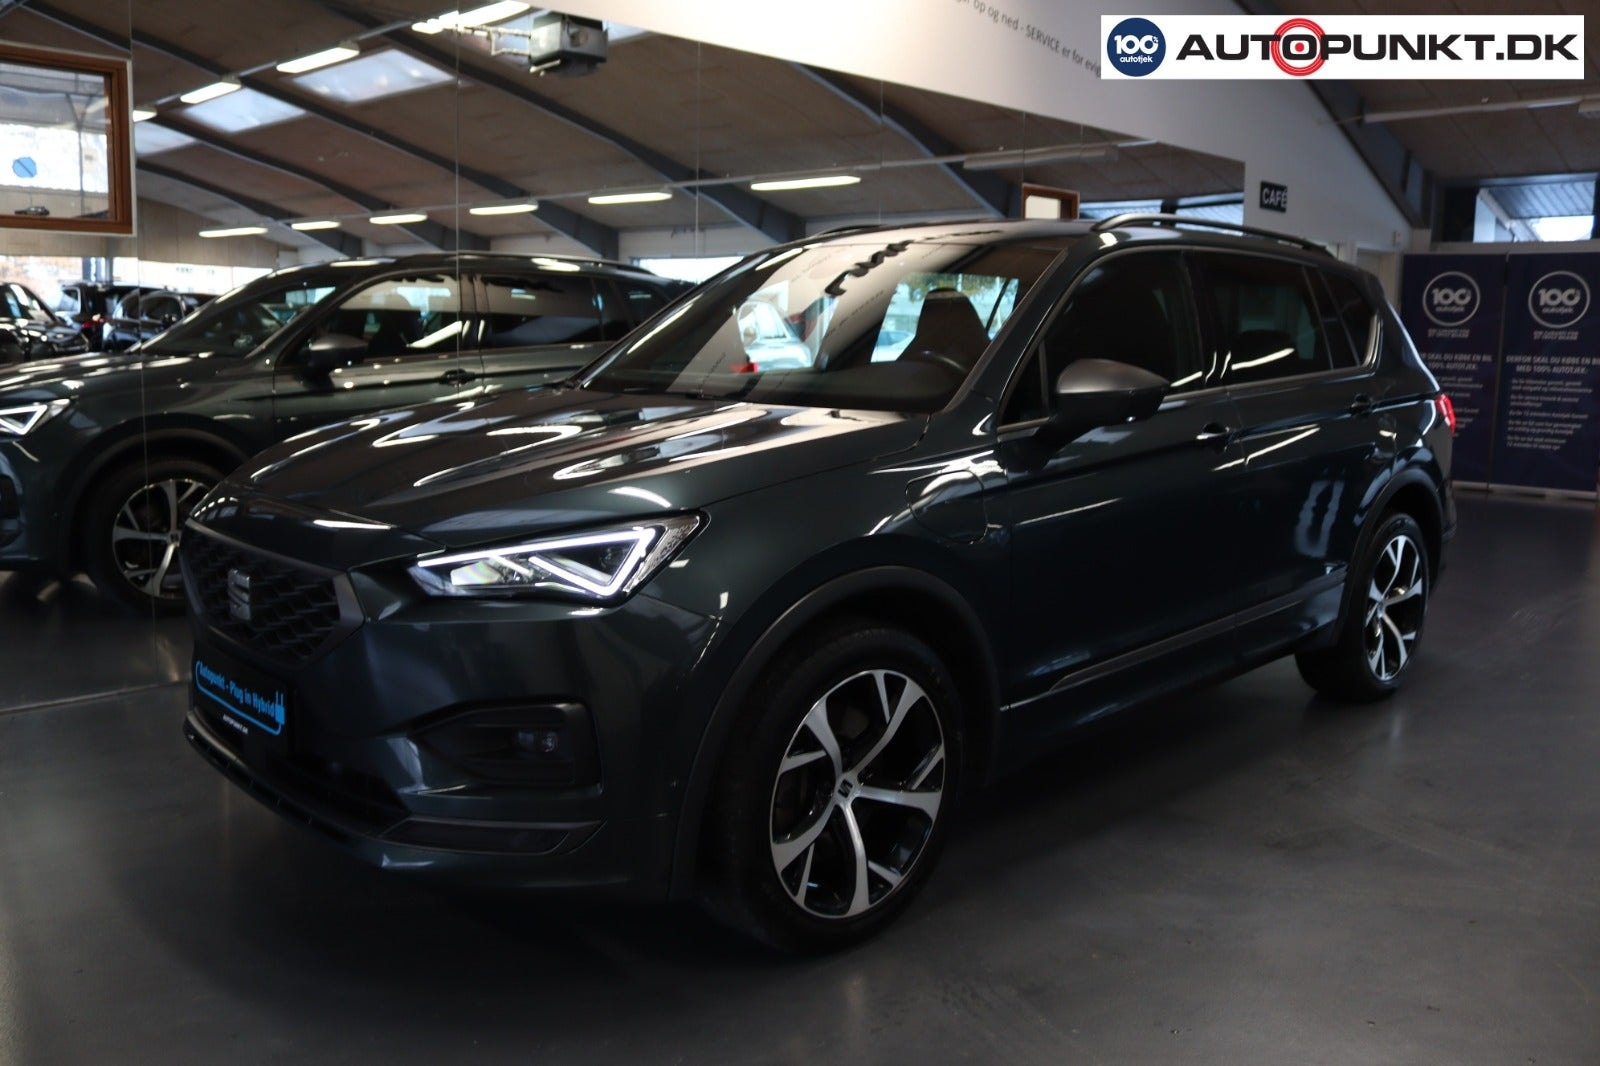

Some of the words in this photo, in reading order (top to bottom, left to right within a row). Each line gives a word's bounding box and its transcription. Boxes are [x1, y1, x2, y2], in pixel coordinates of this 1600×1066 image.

[987, 6, 1000, 23] og
[1001, 14, 1019, 31] ned
[1025, 24, 1060, 54] SERVICE
[1062, 47, 1071, 58] er
[1072, 50, 1084, 65] for
[229, 680, 243, 704] Plug
[244, 687, 252, 706] in
[252, 691, 275, 718] Hybrid
